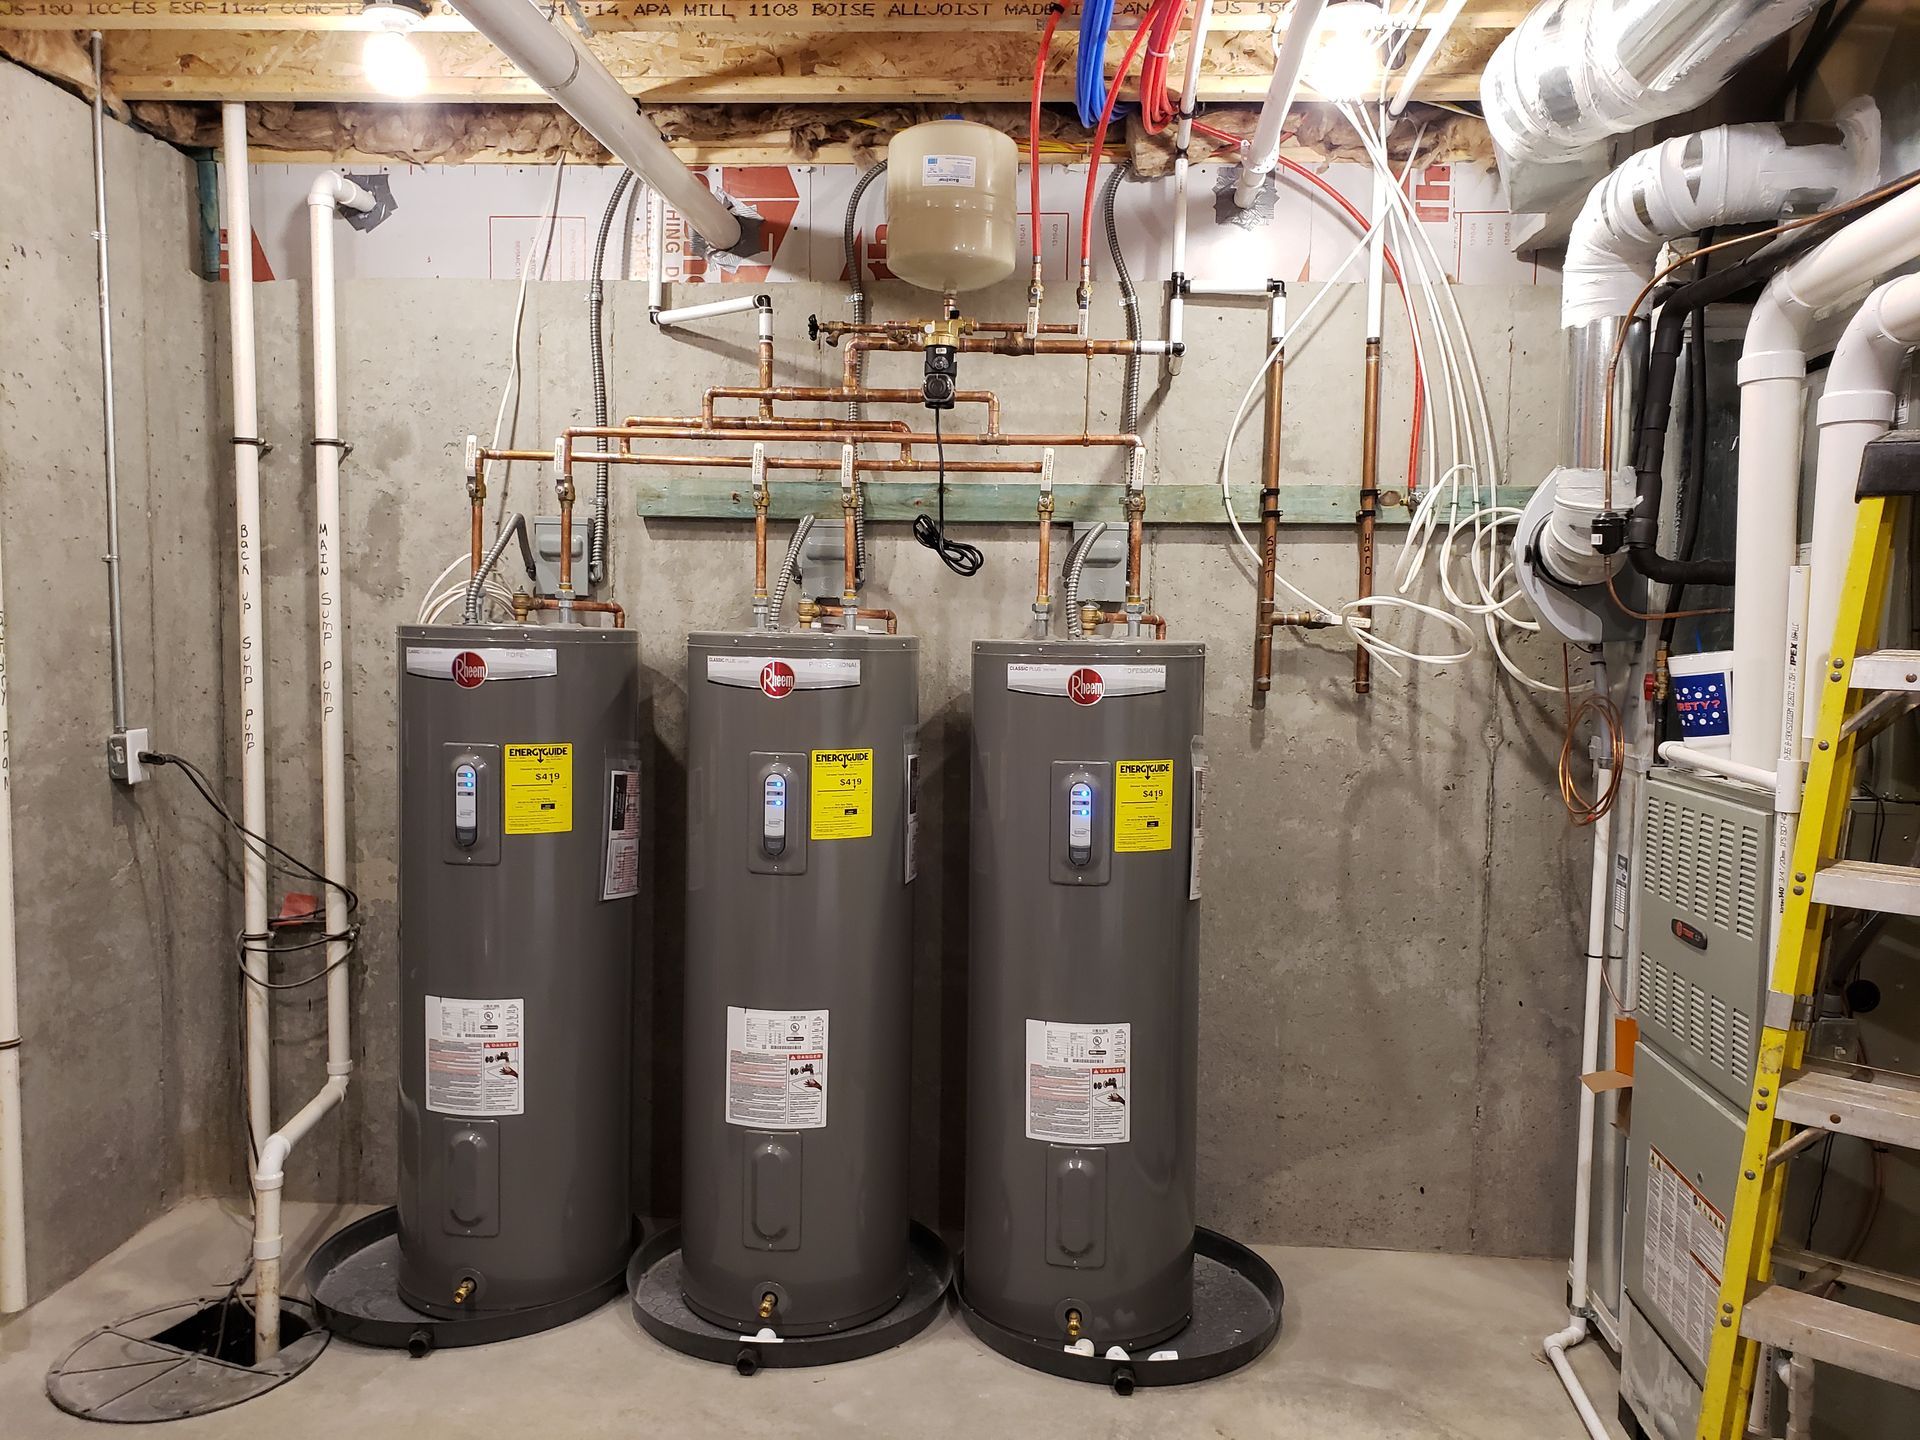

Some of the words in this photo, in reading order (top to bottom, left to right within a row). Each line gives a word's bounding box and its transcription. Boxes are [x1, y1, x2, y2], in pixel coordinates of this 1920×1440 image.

[0, 4, 73, 15] JS-150
[87, 3, 157, 14] ICC-ES
[169, 2, 268, 14] ESR-1144
[634, 4, 671, 16] APA
[684, 4, 734, 16] MILL
[749, 4, 798, 16] 1108
[812, 4, 875, 16] BOISE
[1212, 2, 1241, 14] JS
[319, 523, 329, 575] MAIN
[456, 653, 485, 683] Rheem
[1789, 643, 1798, 665] IPEX
[763, 661, 793, 691] Rheem
[1072, 669, 1102, 699] Rheem
